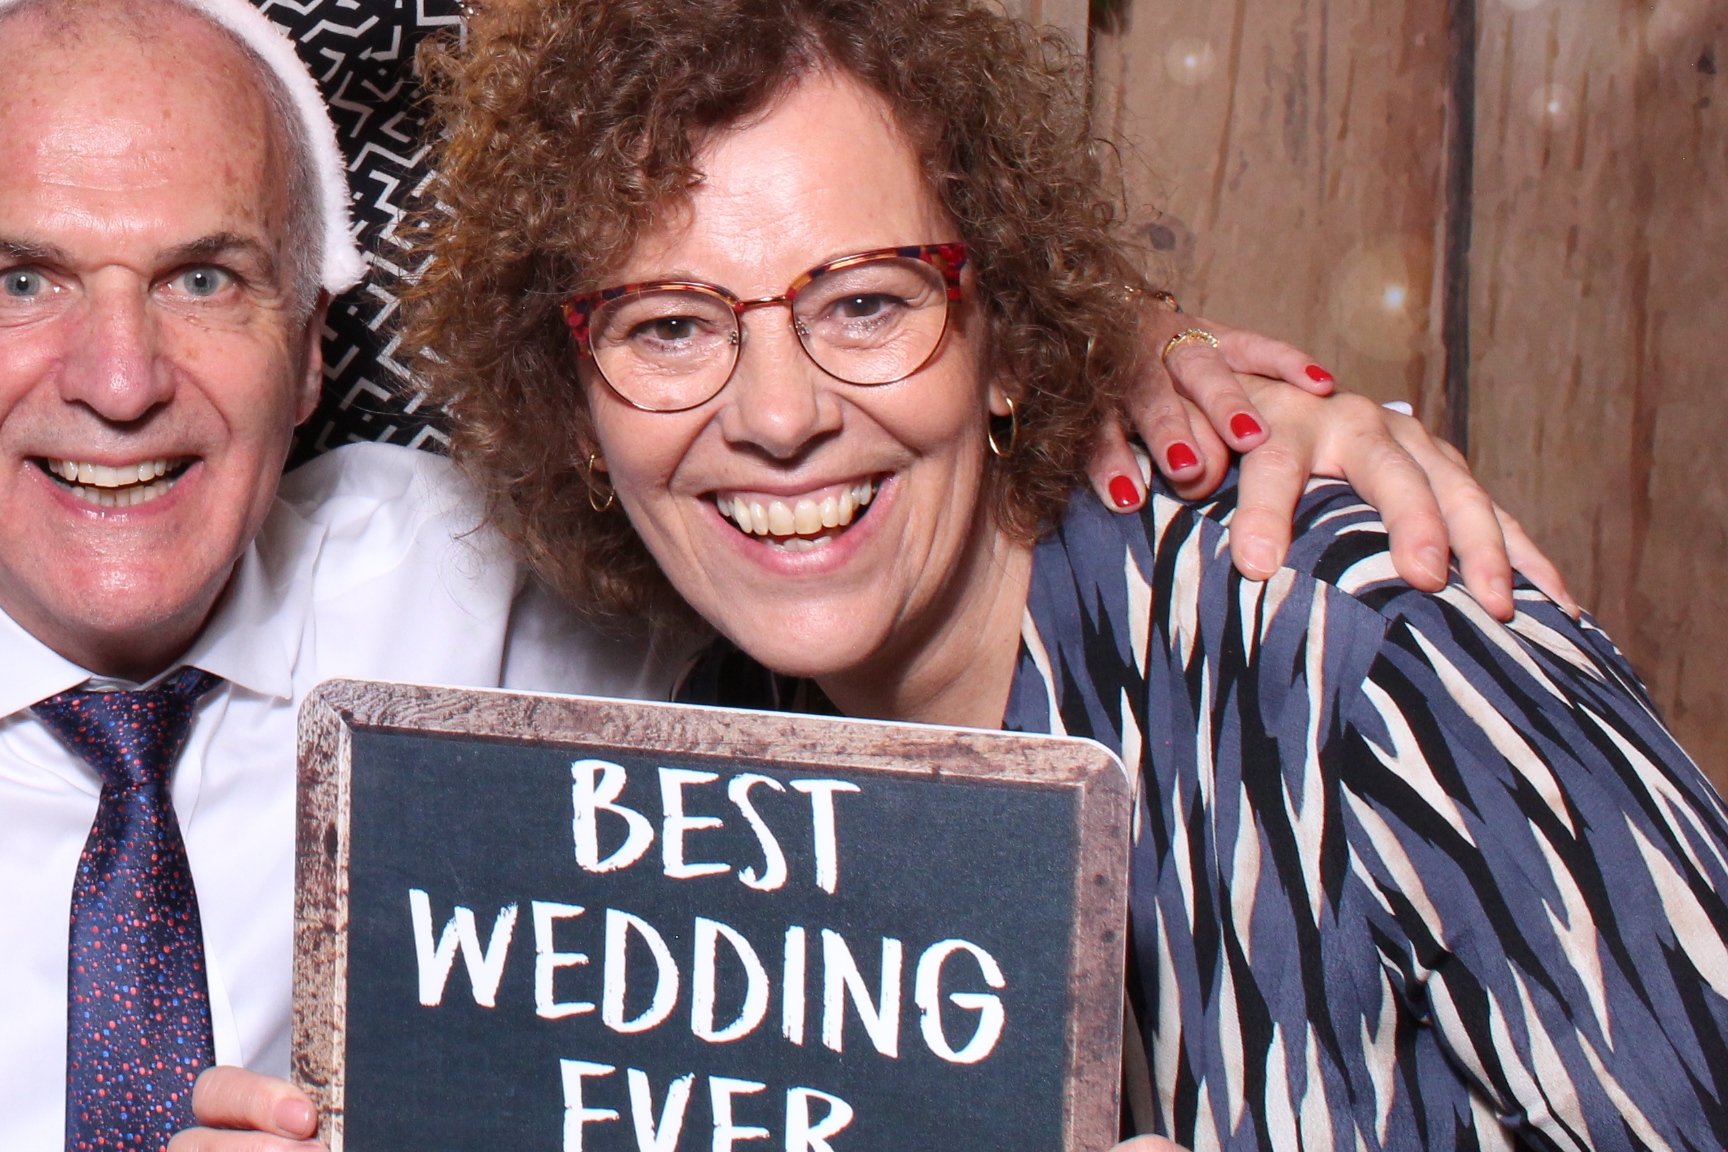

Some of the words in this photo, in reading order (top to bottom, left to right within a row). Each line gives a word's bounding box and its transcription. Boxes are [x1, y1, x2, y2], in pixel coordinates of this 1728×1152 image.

[571, 759, 862, 895] BEST
[408, 887, 1006, 1065] WEDDING
[559, 1058, 855, 1152] EVER
